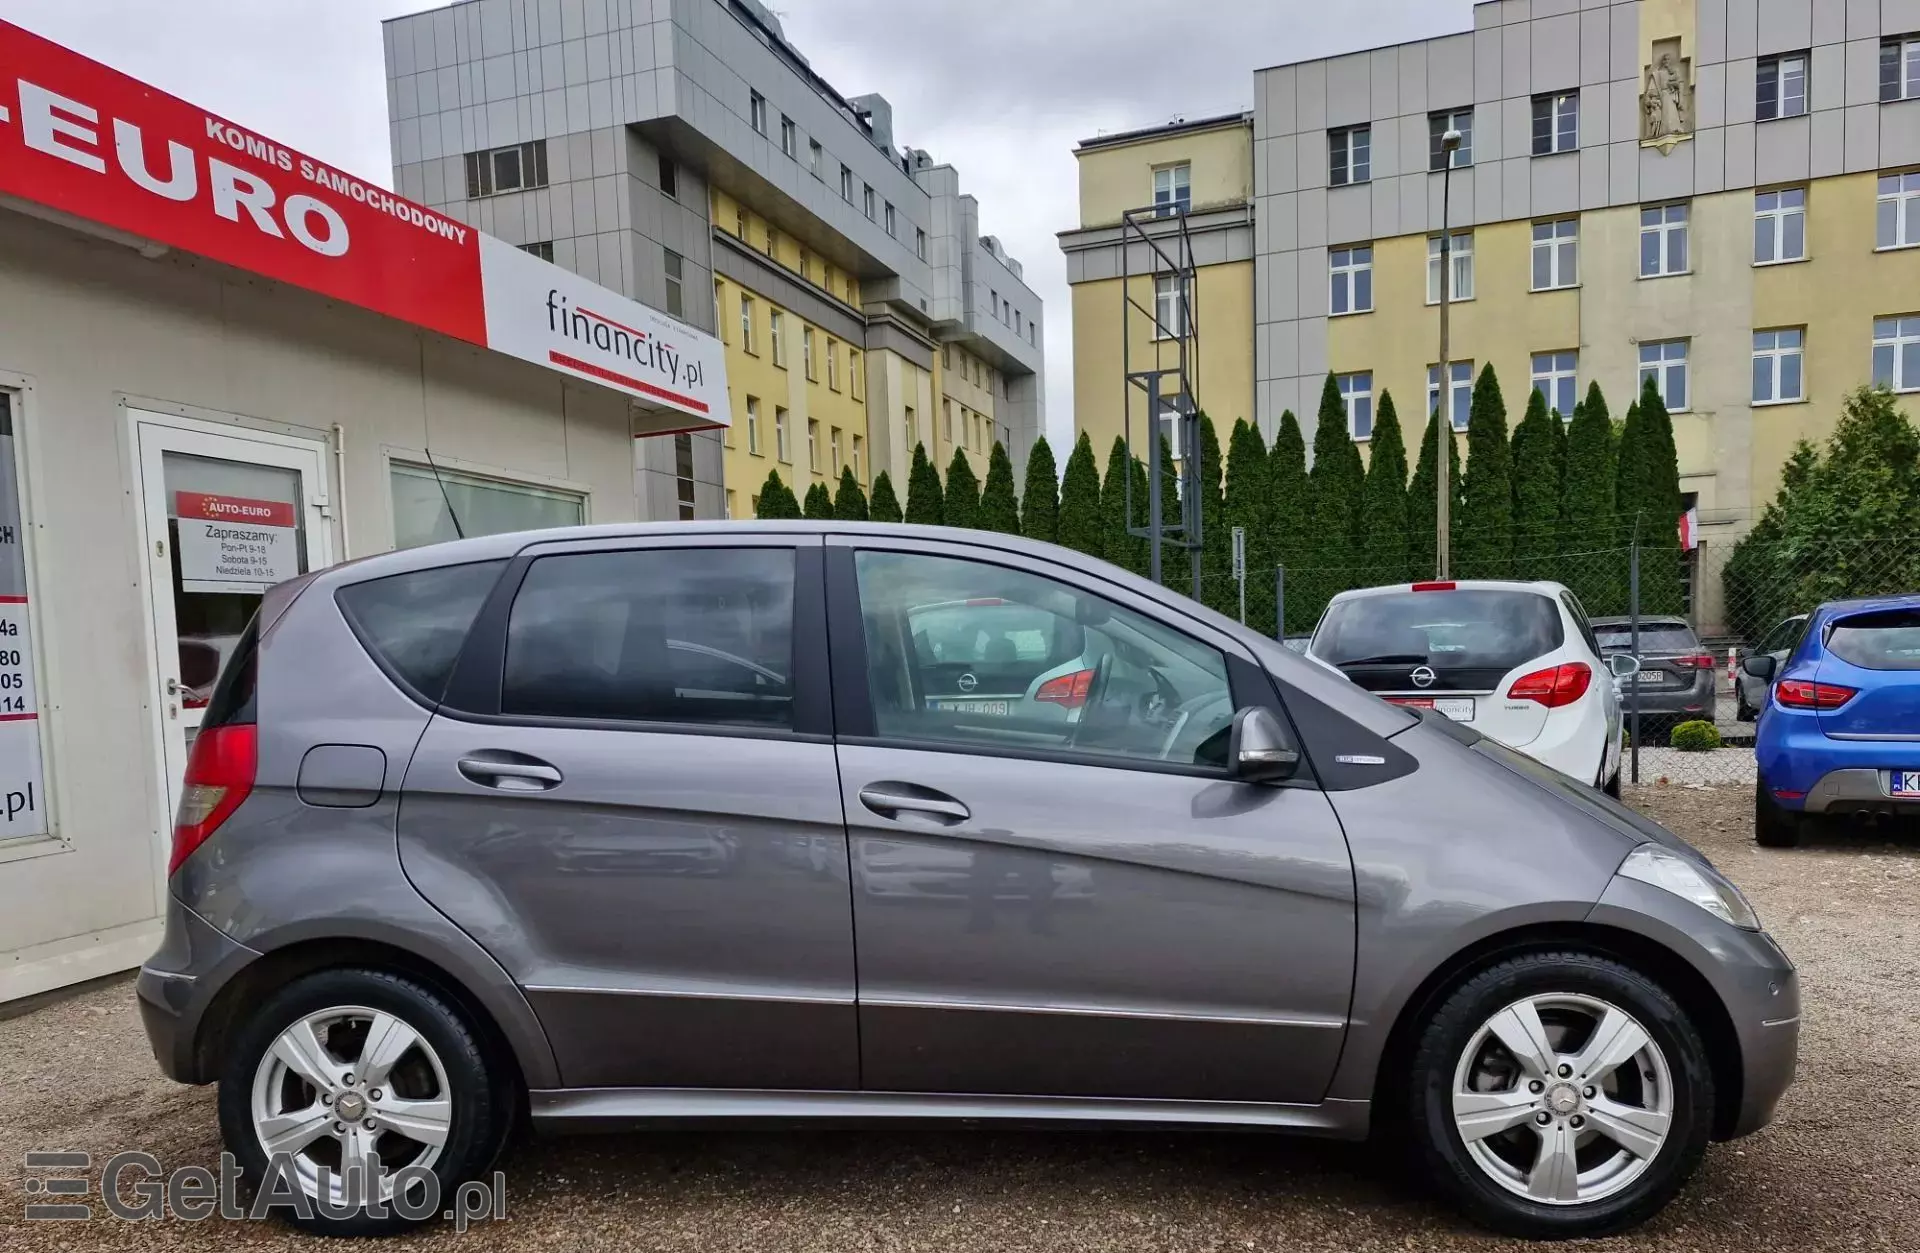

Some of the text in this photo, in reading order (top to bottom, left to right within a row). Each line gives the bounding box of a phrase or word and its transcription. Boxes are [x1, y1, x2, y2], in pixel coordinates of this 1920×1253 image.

[0, 78, 350, 257] EURO
[205, 117, 467, 246] KOMIS SAMOCHODOWY
[546, 289, 704, 389] financity.pl
[209, 502, 272, 518] AUTO-EURO
[205, 525, 278, 545] Zapraszamy:
[221, 542, 266, 554] Pon-Pt 9-18
[221, 554, 267, 566] Sobota 9-15
[215, 565, 275, 577] Niedziela 10-15
[0, 618, 18, 637] 4a
[0, 650, 21, 667] 80
[0, 673, 23, 690] 05
[0, 695, 25, 713] 14
[1904, 773, 1920, 791] K
